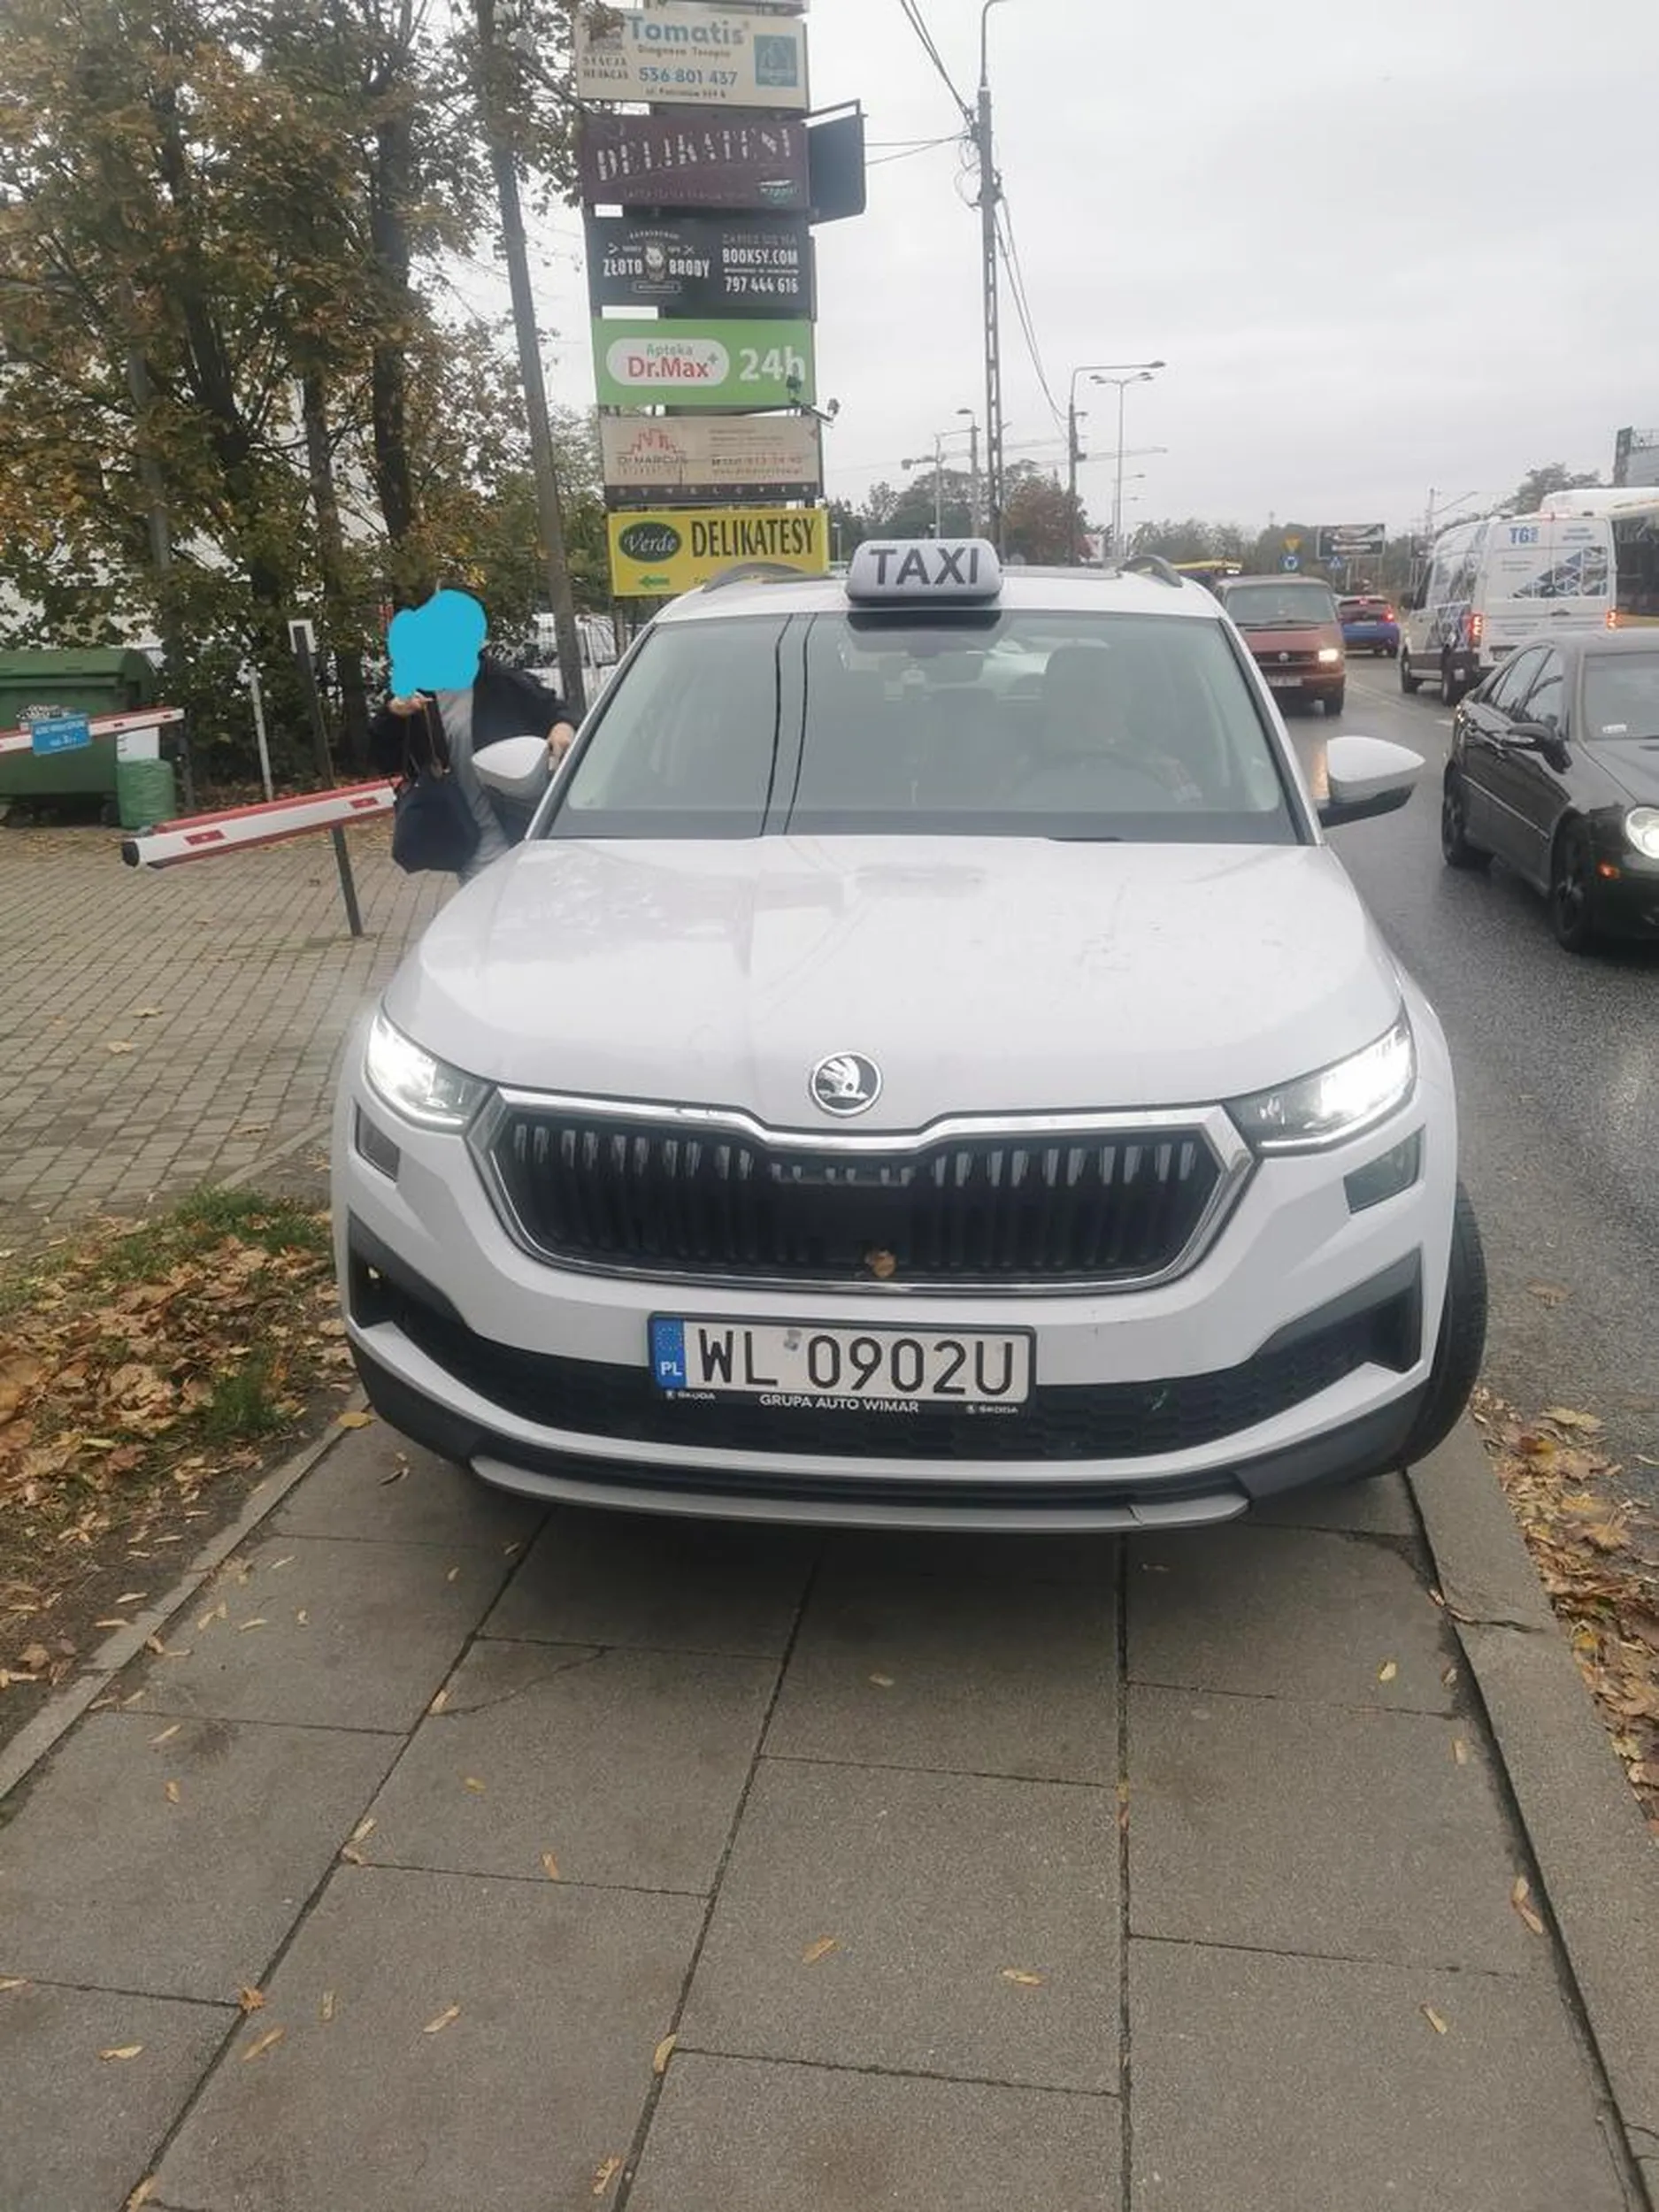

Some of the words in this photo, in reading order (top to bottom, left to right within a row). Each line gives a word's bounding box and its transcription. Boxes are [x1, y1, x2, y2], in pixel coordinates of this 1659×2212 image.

[627, 16, 745, 45] Tomatis
[639, 67, 670, 82] 536
[675, 69, 703, 84] 801
[722, 248, 798, 265] BOOKSY.COM
[669, 258, 710, 279] BRODY
[725, 276, 747, 293] 797
[750, 277, 774, 293] 444
[647, 343, 693, 357] Apteka
[627, 356, 709, 379] Dr.Max
[739, 346, 806, 382] 24h
[625, 532, 677, 552] Verde
[690, 518, 816, 558] DELIKATESY
[869, 547, 979, 586] TAXI
[661, 1363, 682, 1376] PL
[698, 1328, 778, 1386] WL
[807, 1334, 1014, 1396] 0902U
[758, 1394, 812, 1409] GRUPA
[815, 1396, 859, 1410] AUTO
[862, 1398, 919, 1413] WIMAR
